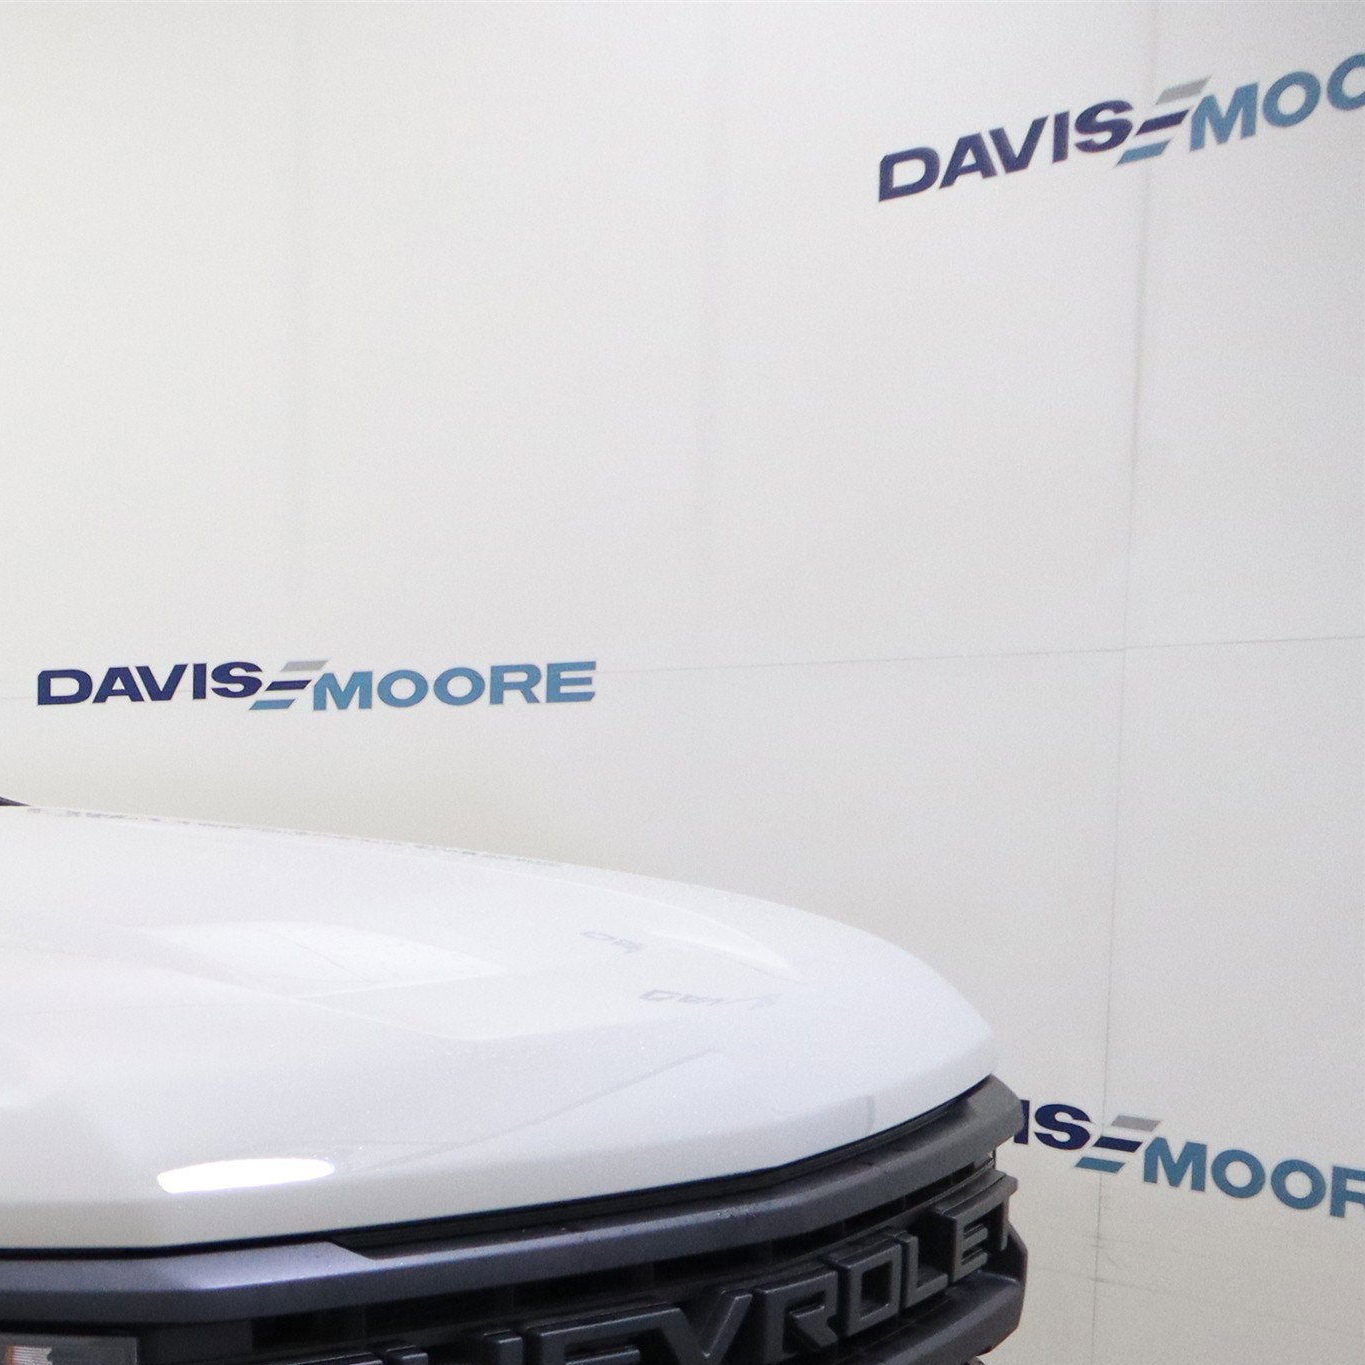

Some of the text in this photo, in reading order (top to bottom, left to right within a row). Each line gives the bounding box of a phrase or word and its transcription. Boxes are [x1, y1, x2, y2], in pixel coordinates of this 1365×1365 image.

[877, 98, 1135, 202] DAVIS
[36, 660, 597, 712] DAVIS MOORE
